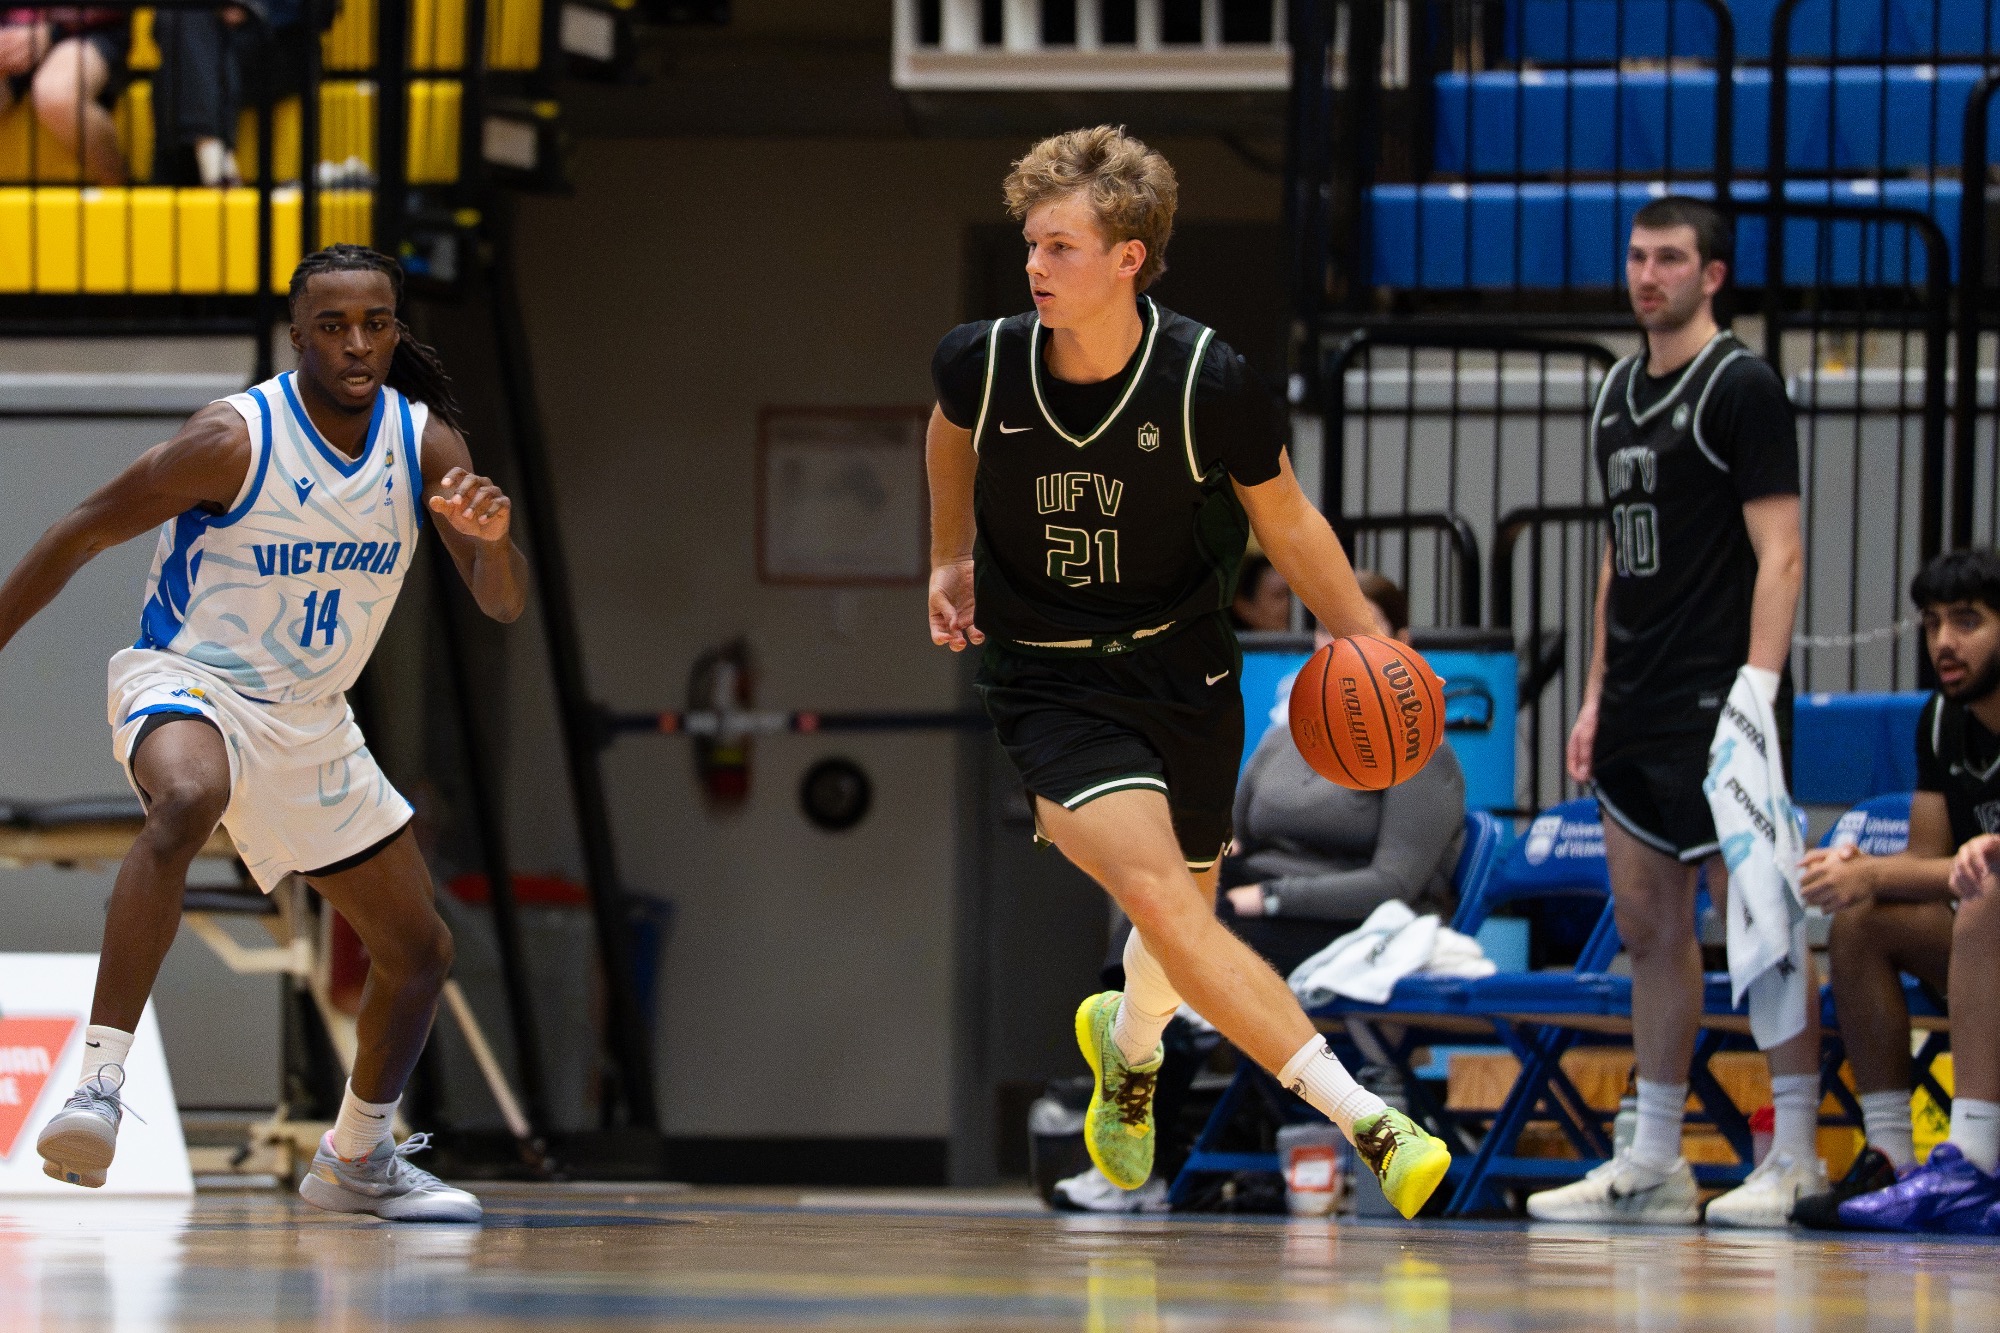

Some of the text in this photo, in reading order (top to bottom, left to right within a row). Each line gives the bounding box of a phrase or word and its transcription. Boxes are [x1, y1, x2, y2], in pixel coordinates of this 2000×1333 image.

[1140, 432, 1157, 446] CW
[1036, 471, 1124, 517] UFV
[1608, 446, 1658, 499] UFV
[252, 541, 402, 577] VICTORIA
[1045, 524, 1120, 588] 21
[1613, 503, 1660, 577] 10
[300, 588, 341, 647] 14
[1343, 677, 1378, 769] EVOLUTION
[1382, 658, 1422, 762] Wilson
[1725, 776, 1776, 843] POWER
